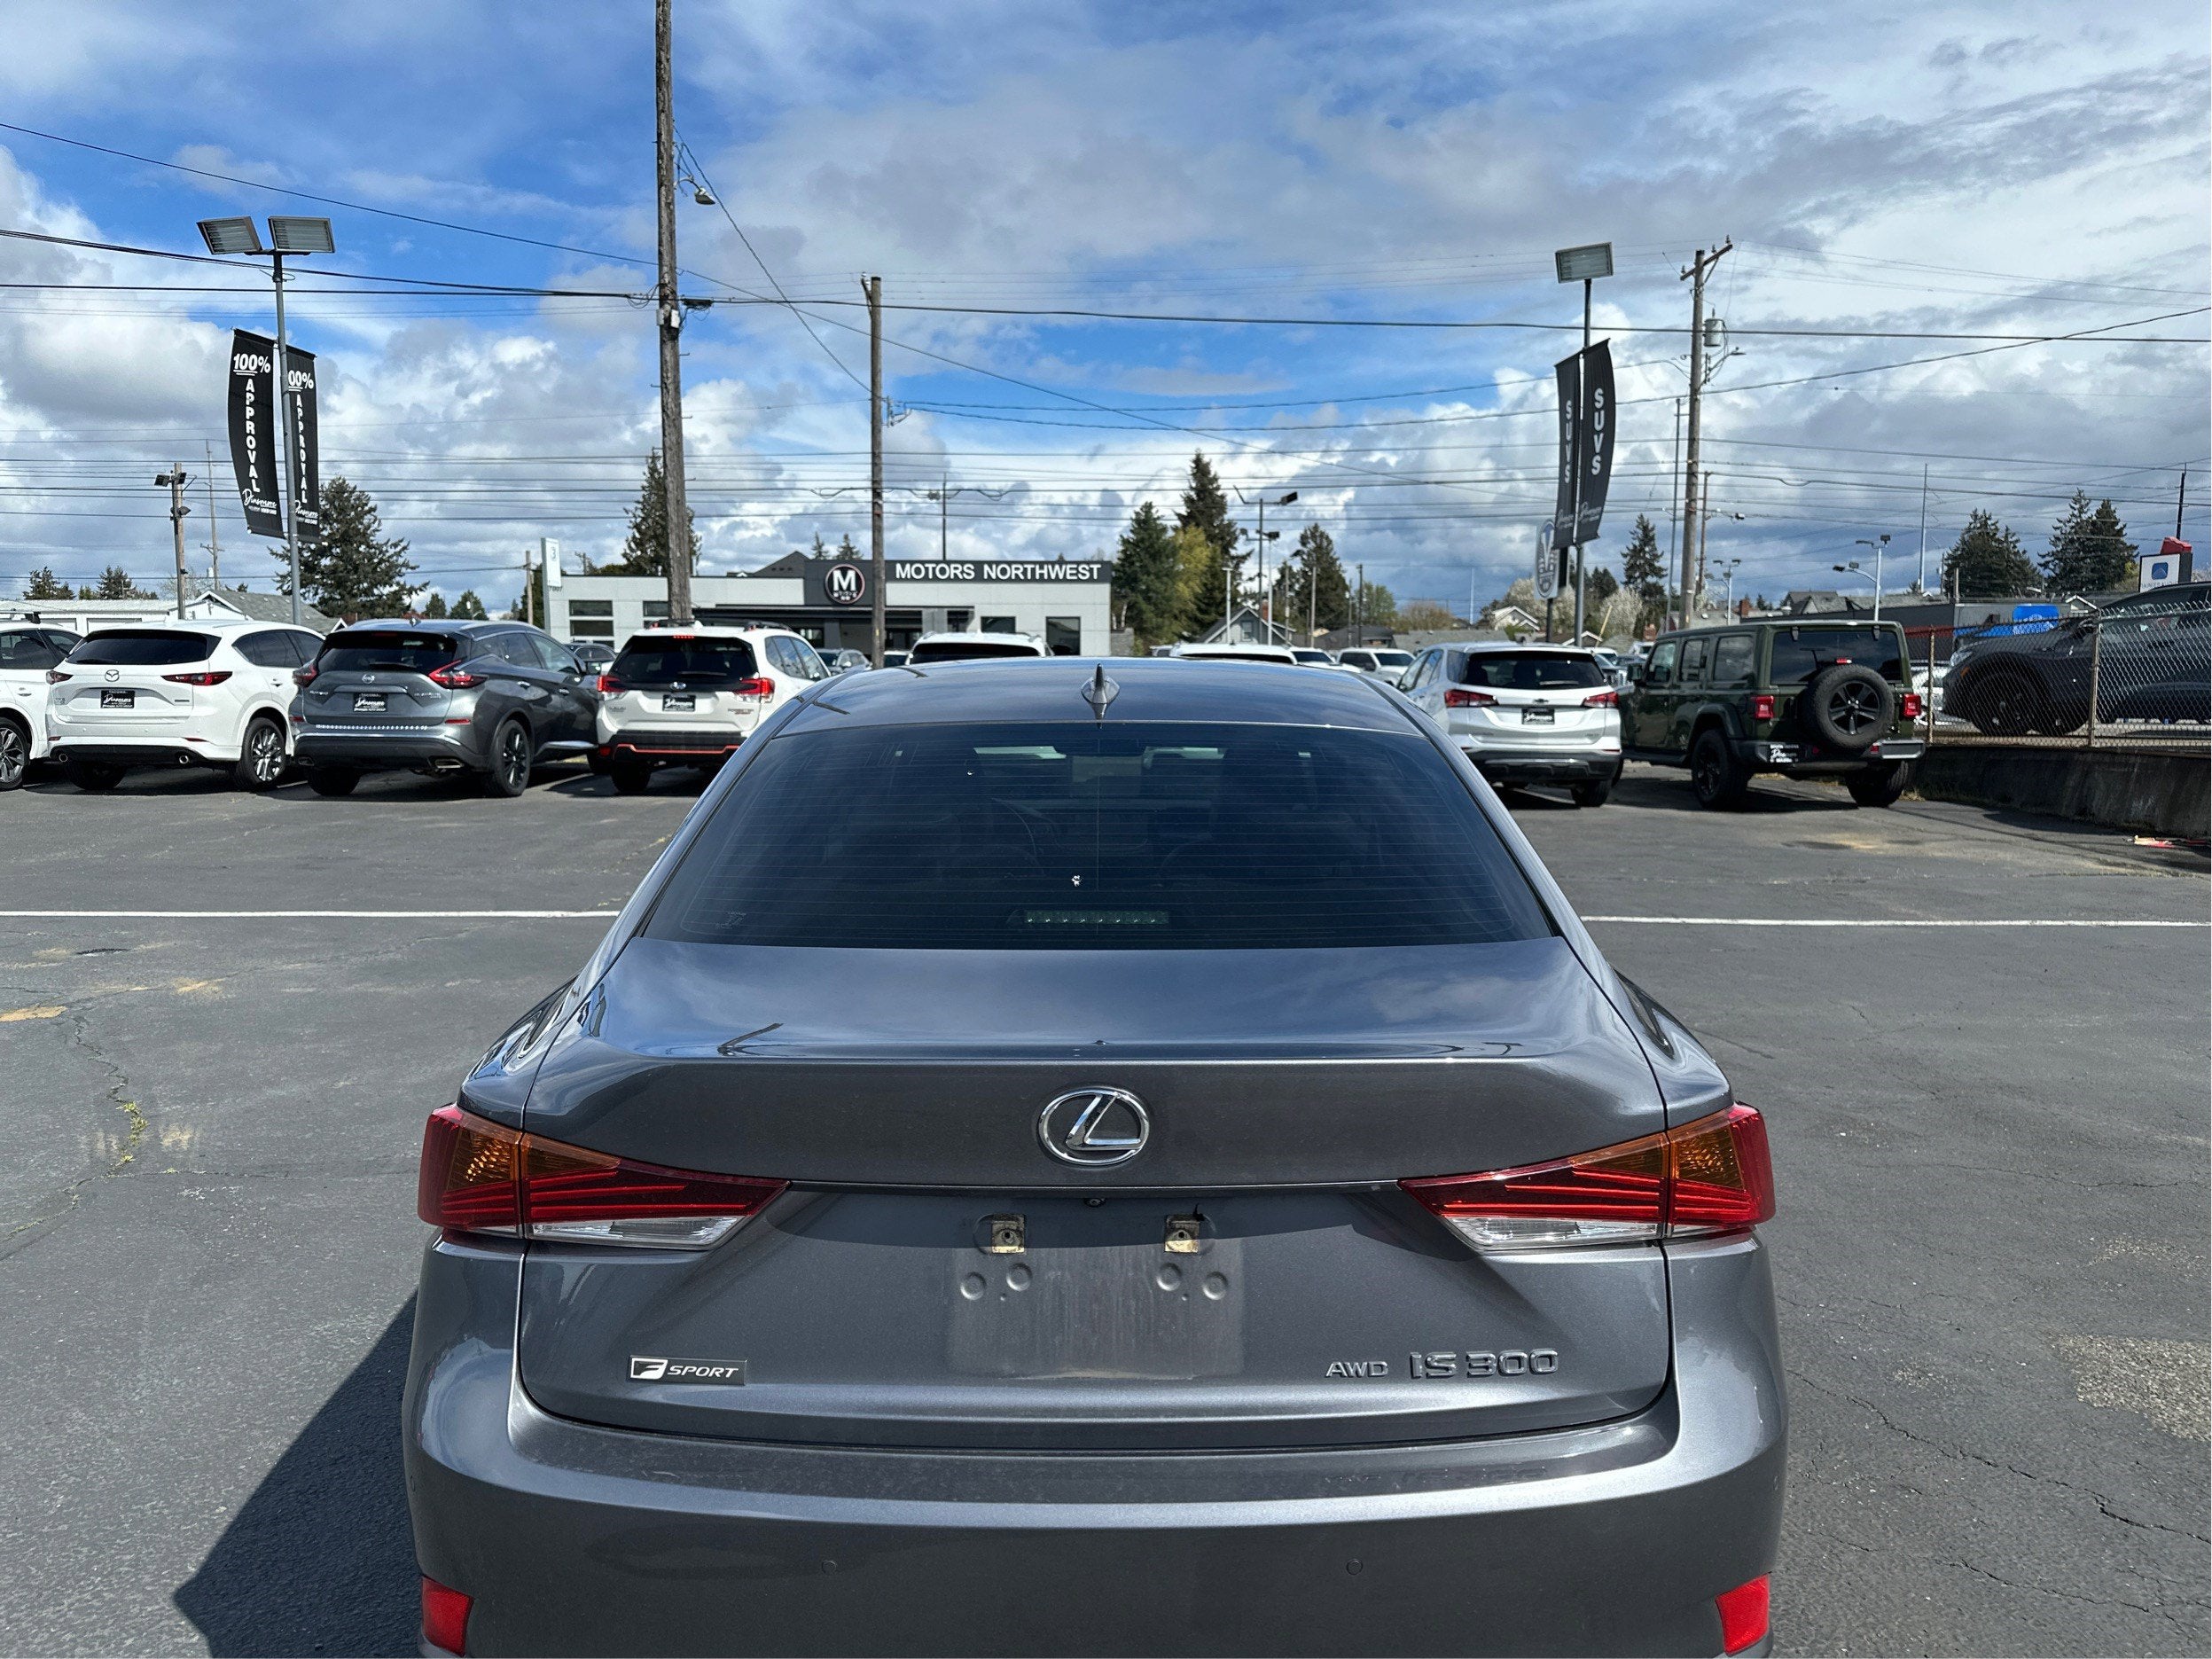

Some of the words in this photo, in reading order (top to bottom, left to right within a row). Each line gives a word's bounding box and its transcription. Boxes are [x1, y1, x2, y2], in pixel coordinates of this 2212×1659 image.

[232, 353, 271, 374] 100%
[287, 369, 315, 390] 00%
[245, 378, 261, 493] APPROVAL
[1591, 387, 1606, 476] SUVS
[295, 394, 308, 504] APPROVAL
[833, 569, 856, 591] M
[895, 562, 975, 580] MOTORS
[983, 564, 1102, 580] NORTHWEST
[668, 1366, 739, 1379] SPORT
[1325, 1360, 1389, 1378] AWD
[1409, 1351, 1458, 1379] IS
[1466, 1348, 1559, 1379] 300
